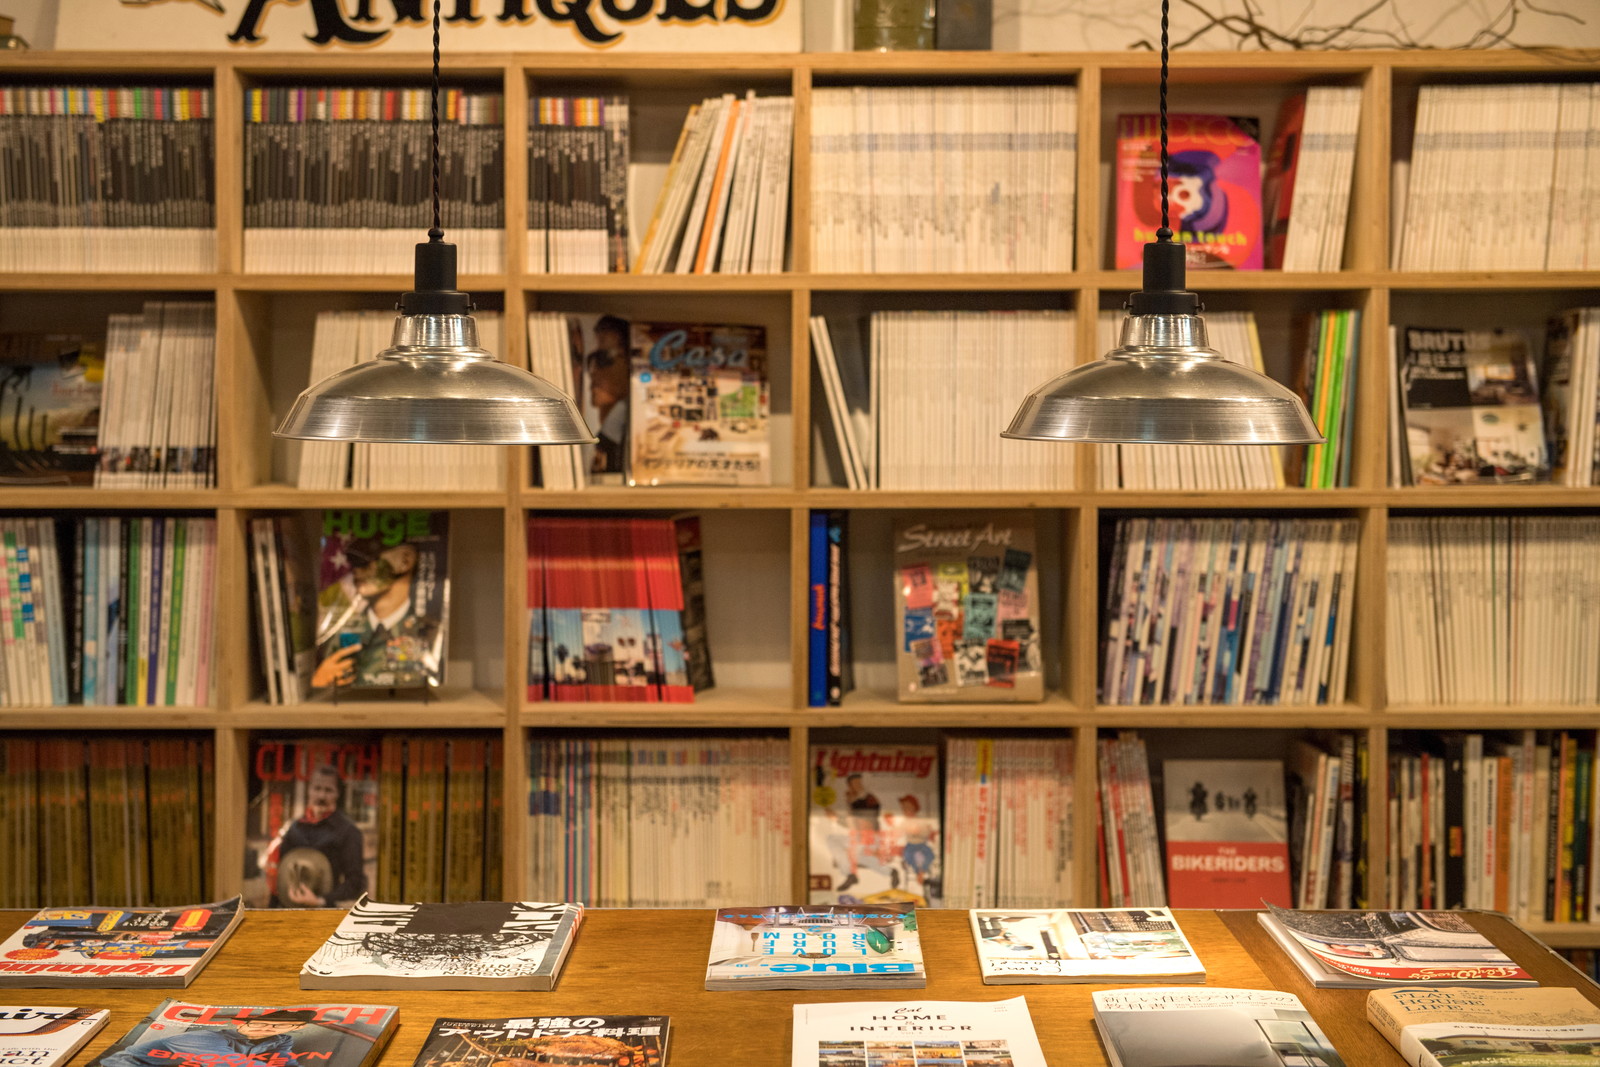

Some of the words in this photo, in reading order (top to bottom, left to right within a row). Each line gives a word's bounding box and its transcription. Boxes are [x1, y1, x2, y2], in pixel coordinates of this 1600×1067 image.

[1133, 228, 1193, 243] huan
[1197, 229, 1247, 245] touch
[649, 330, 749, 371] Casa
[897, 522, 972, 553] Street
[970, 522, 1013, 552] Art
[256, 743, 377, 782] CLUTCH
[815, 749, 935, 778] Lightning
[1217, 847, 1236, 855] THE
[1171, 854, 1285, 872] BIKERIDERS
[763, 932, 866, 940] ROOM
[762, 939, 867, 947] SURF
[761, 947, 867, 955] LOVE
[760, 962, 916, 974] Blue.
[1103, 994, 1294, 1004] 新しい住宅デザインの
[1397, 998, 1485, 1006] HOUSE
[1403, 1004, 1463, 1012] LIFE
[149, 1023, 166, 1031] 6
[502, 1017, 606, 1030] 最強の
[438, 1026, 661, 1039] アウトドア料理
[146, 1048, 333, 1061] BROOKLYN
[177, 1057, 289, 1067] STYLE
